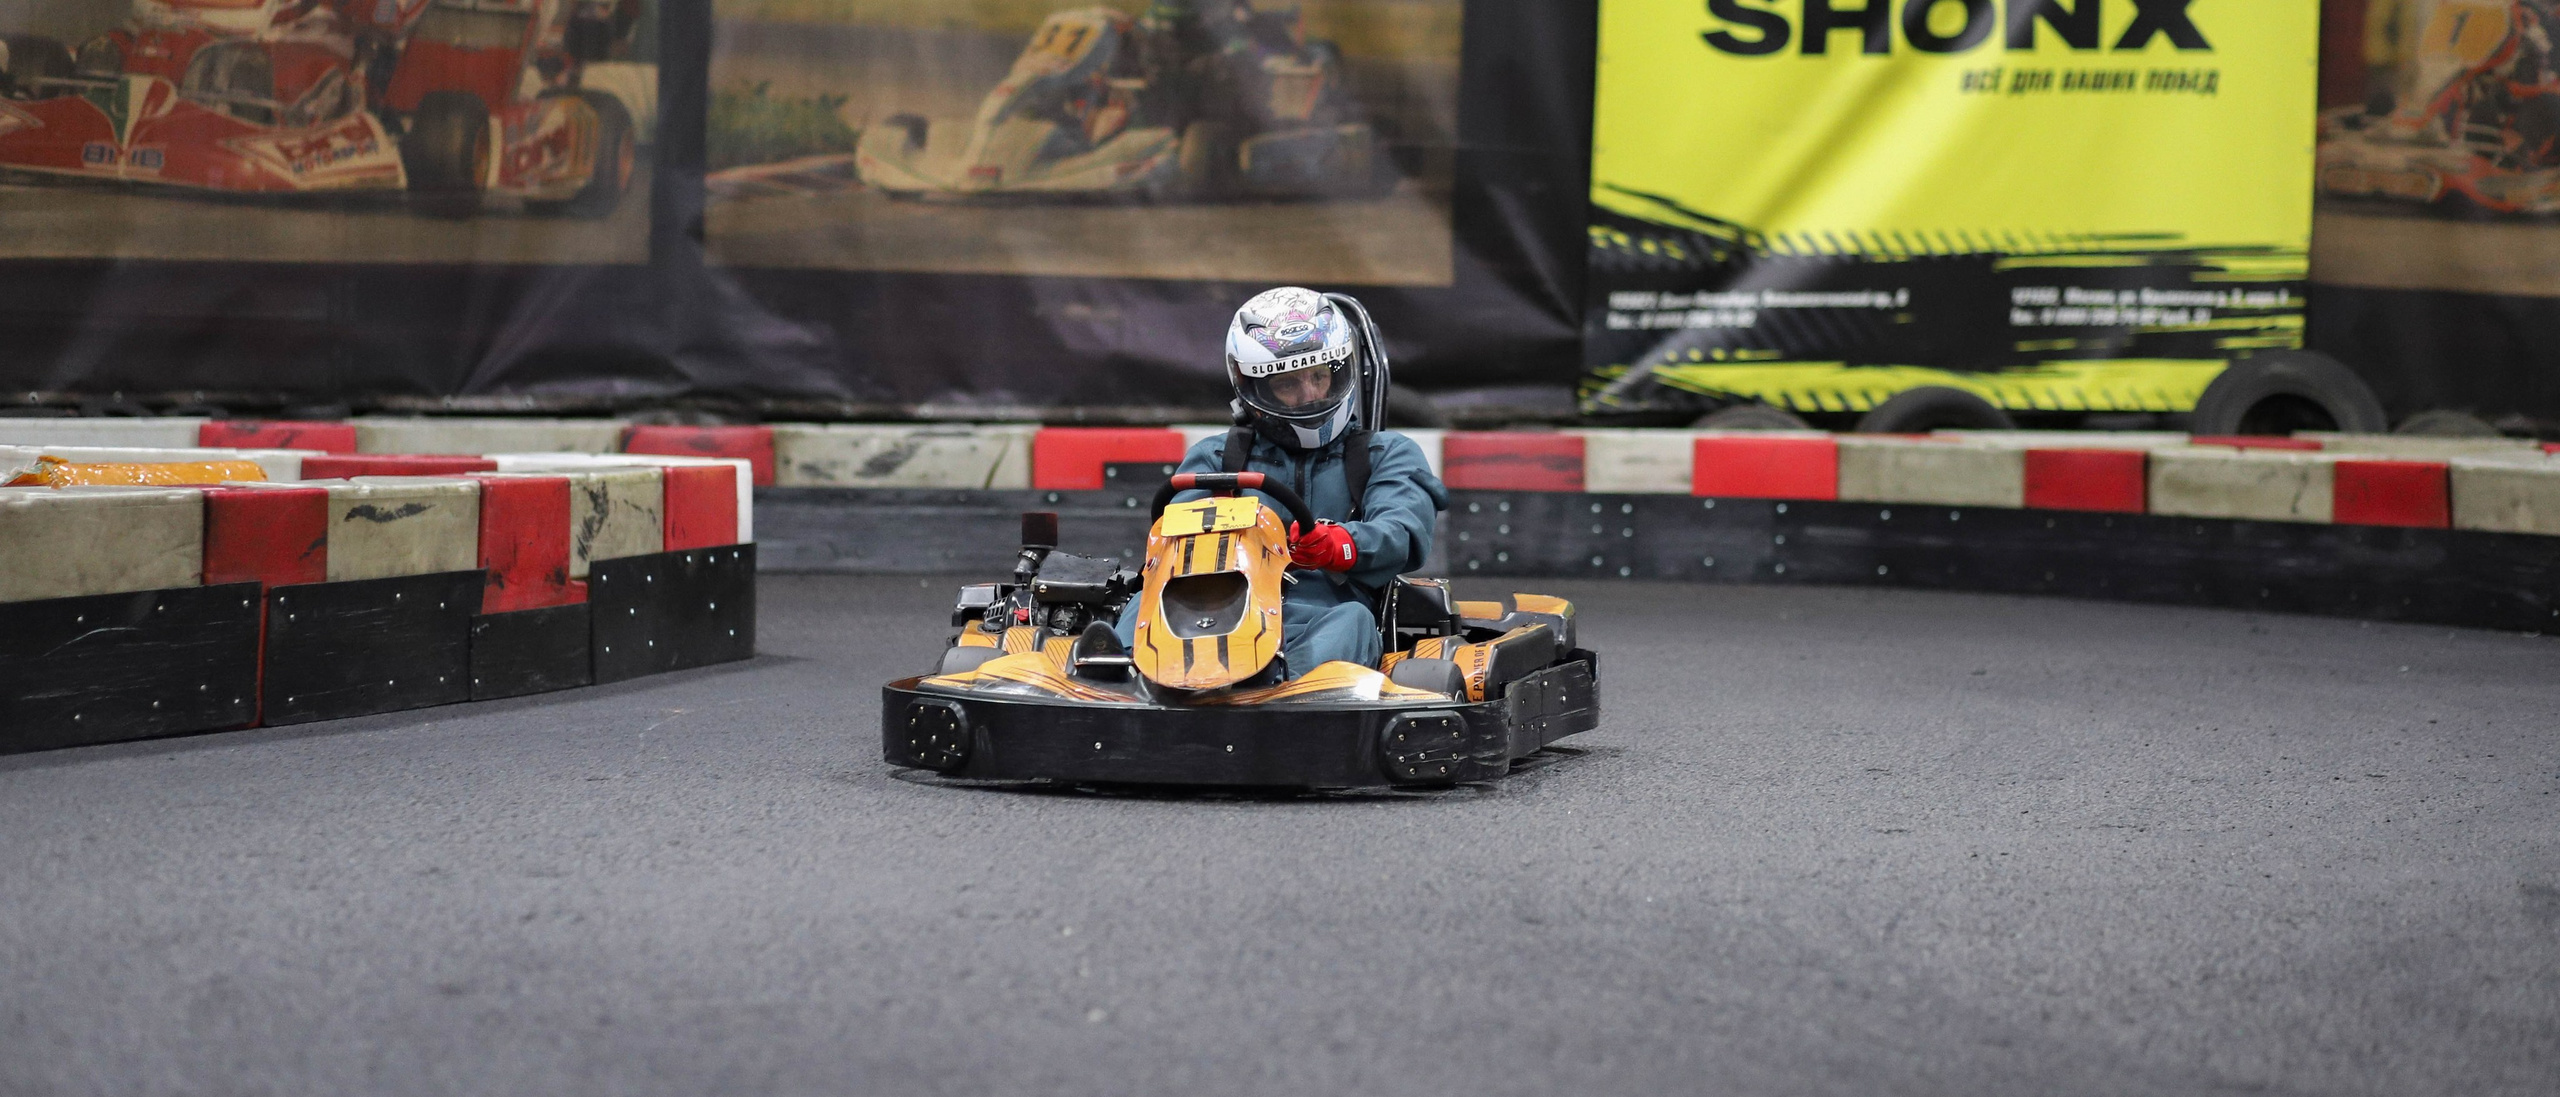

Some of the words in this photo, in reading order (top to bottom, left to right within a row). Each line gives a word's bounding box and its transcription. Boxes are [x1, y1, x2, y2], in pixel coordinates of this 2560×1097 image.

[1701, 0, 2214, 56] SHONX
[1251, 361, 1286, 375] SLOW
[1291, 355, 1317, 369] CAR
[1321, 346, 1347, 360] CLUB
